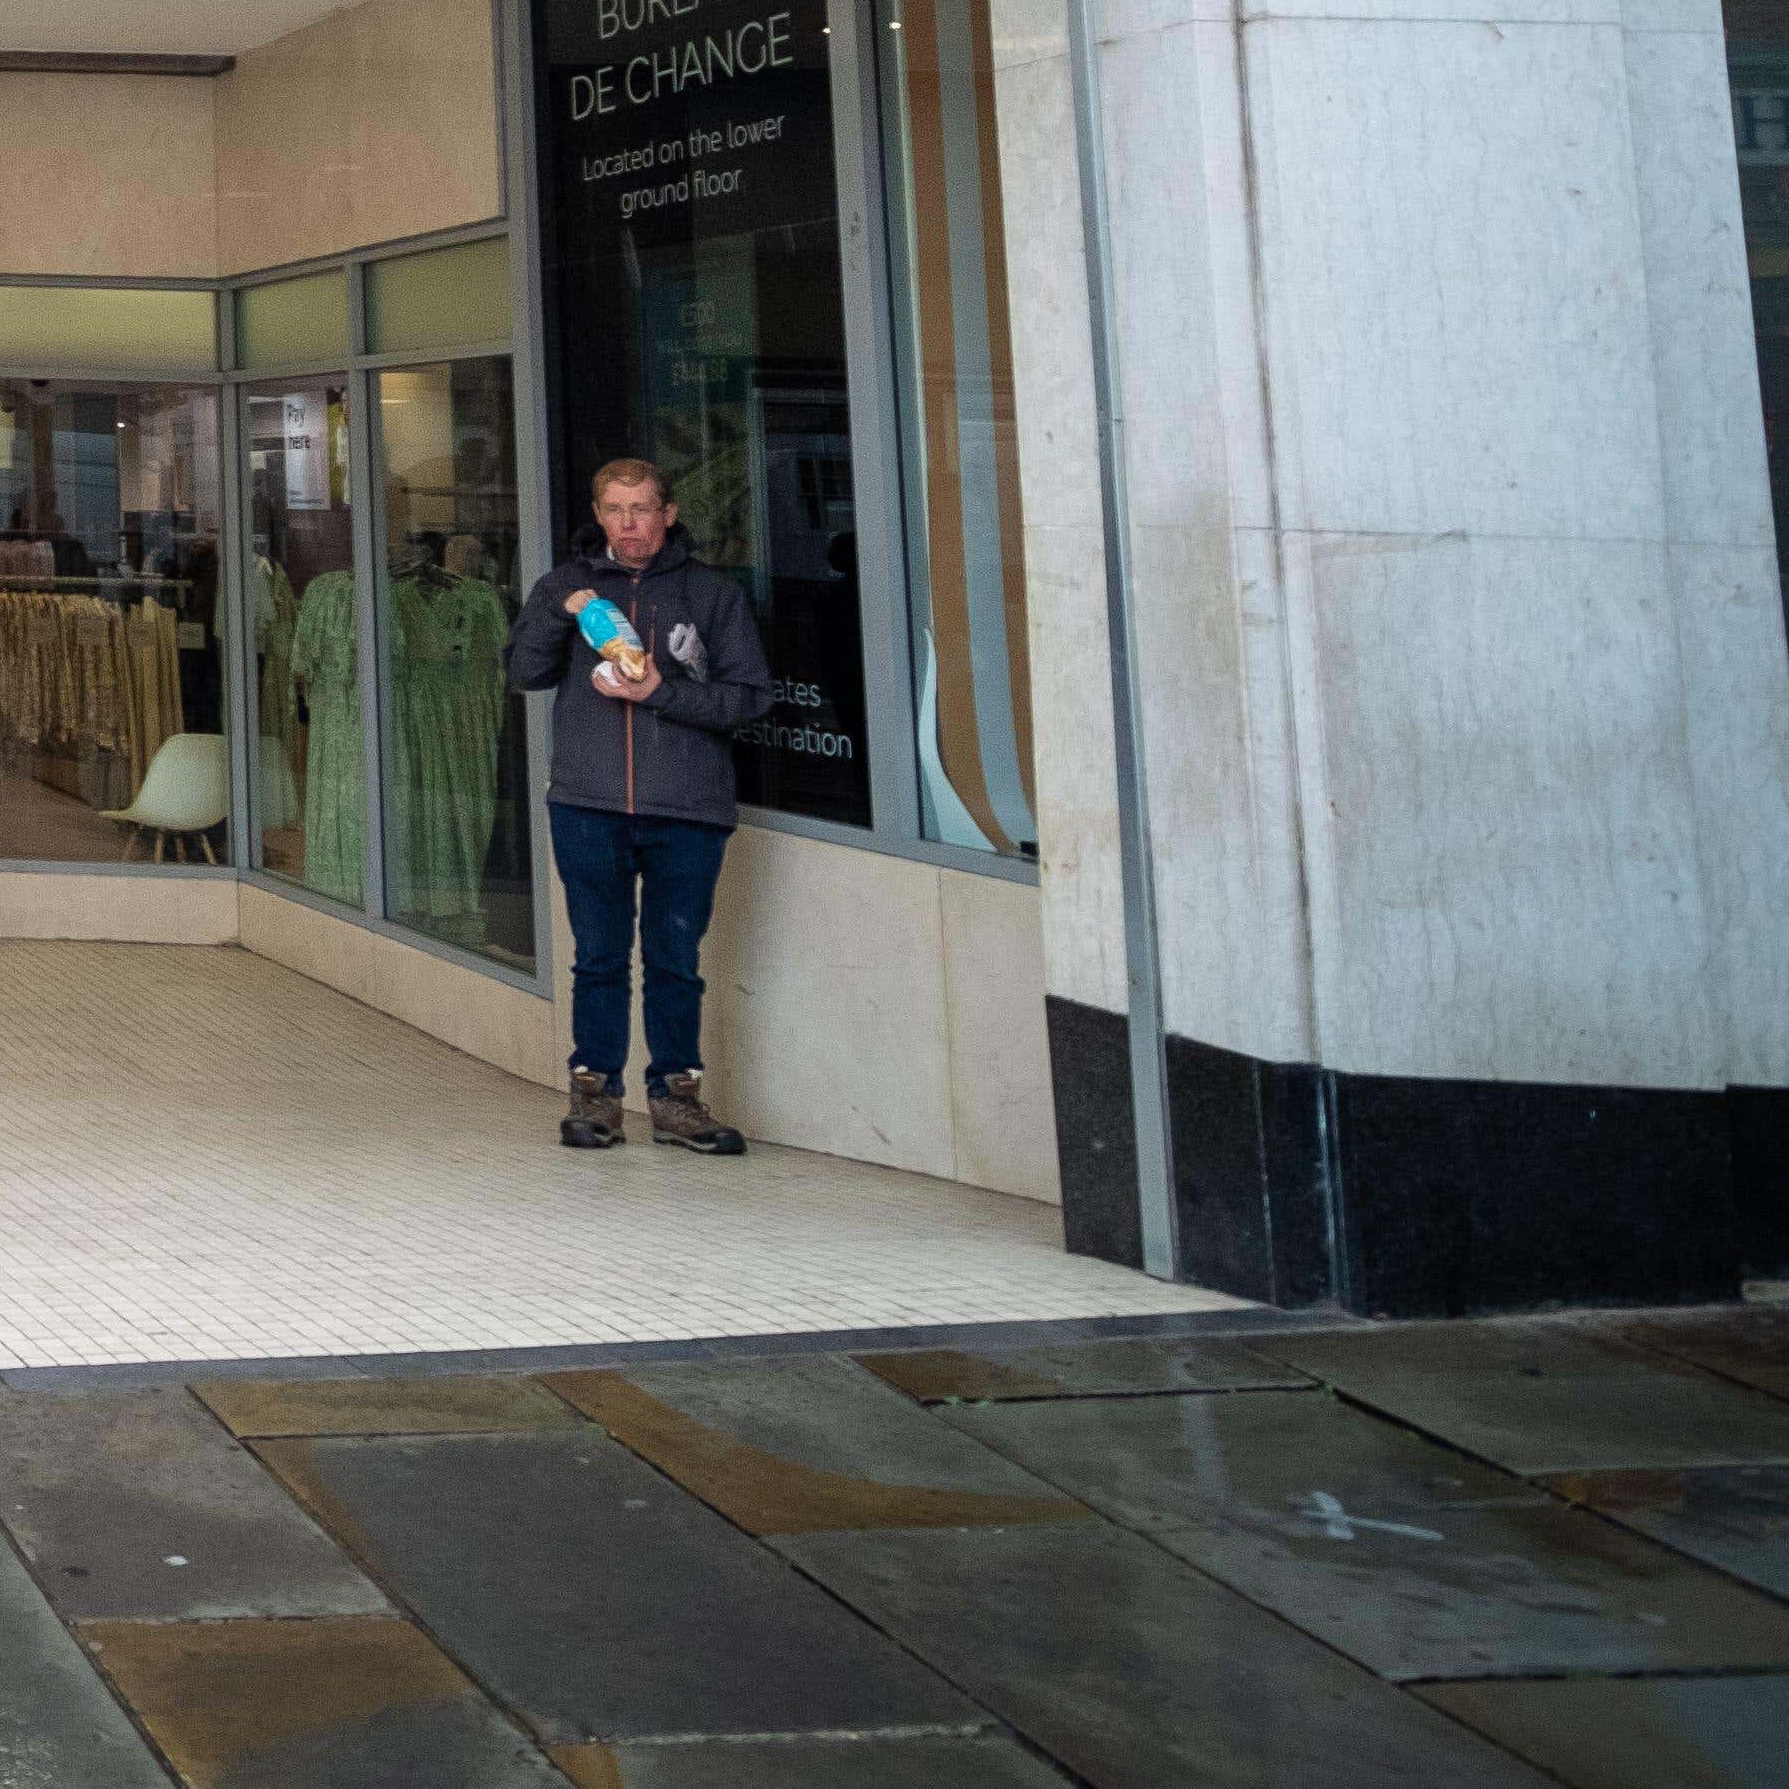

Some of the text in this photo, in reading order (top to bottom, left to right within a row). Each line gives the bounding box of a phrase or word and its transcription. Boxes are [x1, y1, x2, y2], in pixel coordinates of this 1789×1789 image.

[571, 11, 794, 121] DE CHANGE
[582, 114, 786, 181] Located on the lower
[621, 167, 743, 219] ground floor
[771, 675, 821, 707] ates
